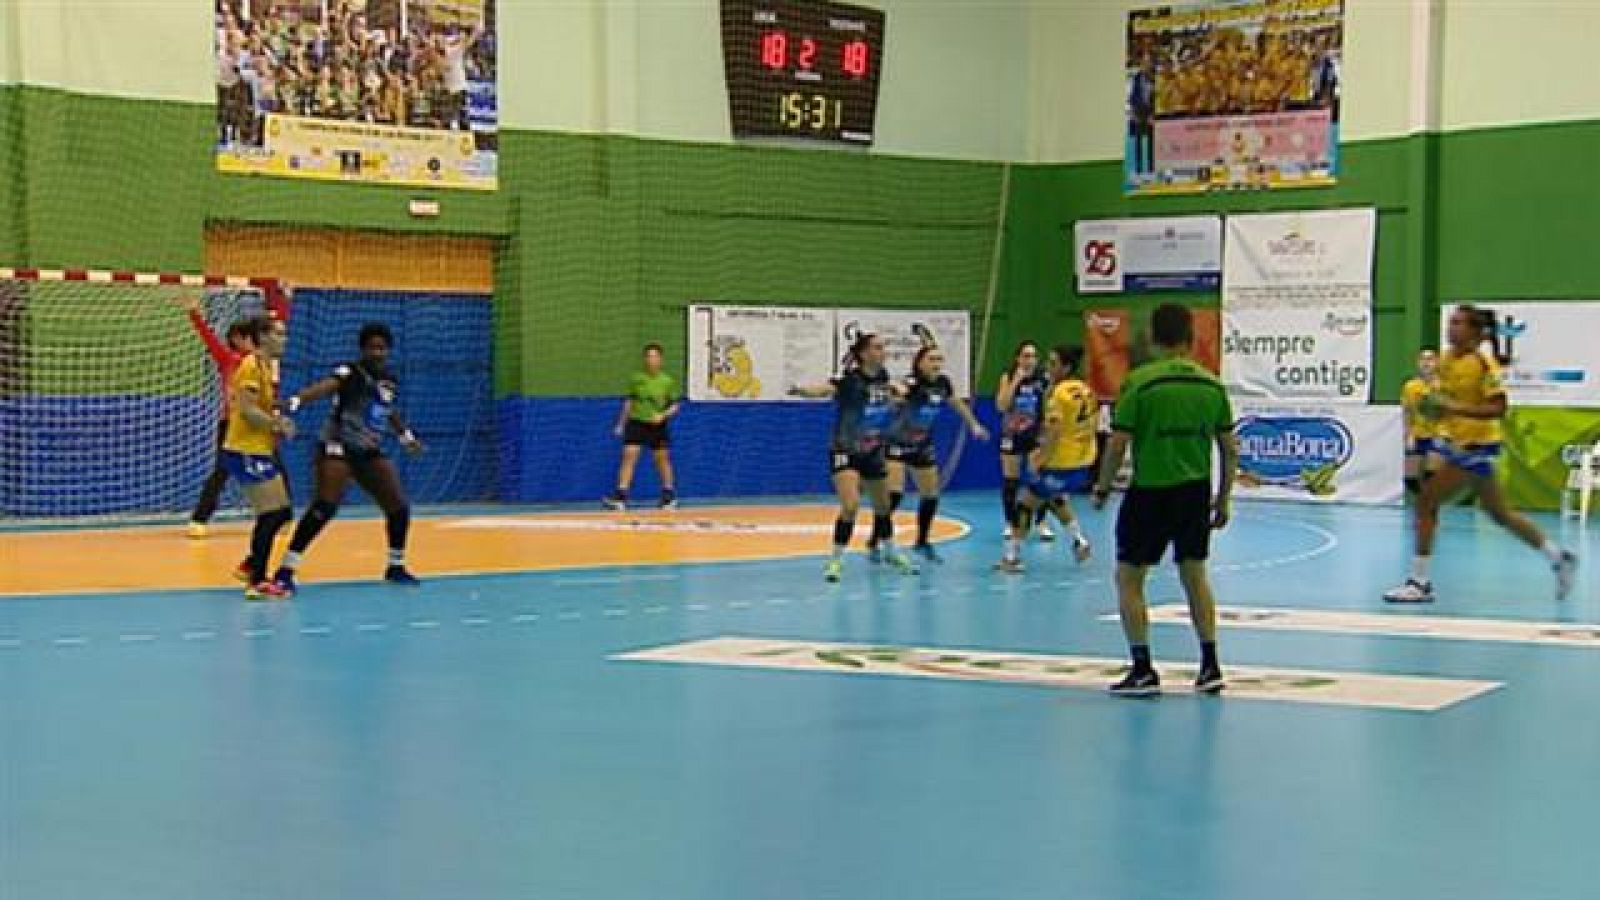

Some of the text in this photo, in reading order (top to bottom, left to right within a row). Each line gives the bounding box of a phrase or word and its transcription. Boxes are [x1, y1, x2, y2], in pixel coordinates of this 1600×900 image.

[762, 33, 867, 75] 18 2 18
[780, 92, 842, 129] 15:31
[1084, 240, 1116, 277] 25
[1224, 329, 1316, 364] siempre
[1275, 360, 1368, 396] contigo
